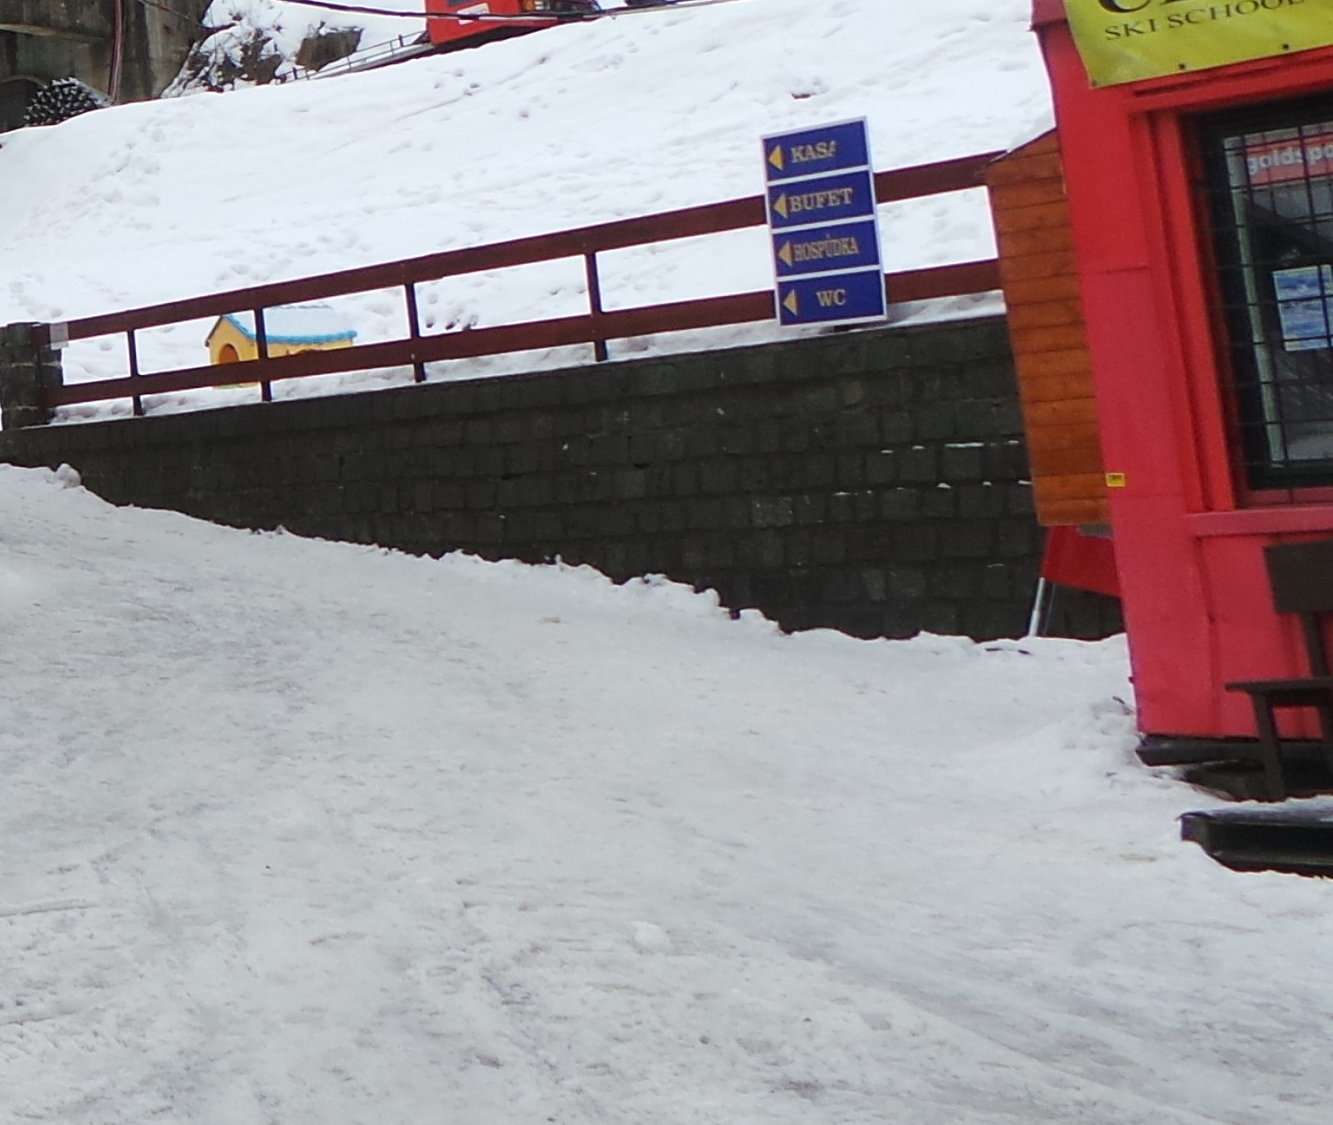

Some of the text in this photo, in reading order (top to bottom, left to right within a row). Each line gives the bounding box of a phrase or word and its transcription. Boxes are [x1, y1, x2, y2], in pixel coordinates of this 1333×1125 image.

[1104, 18, 1157, 41] SKI
[789, 188, 852, 212] BUFET
[816, 288, 847, 307] WC
